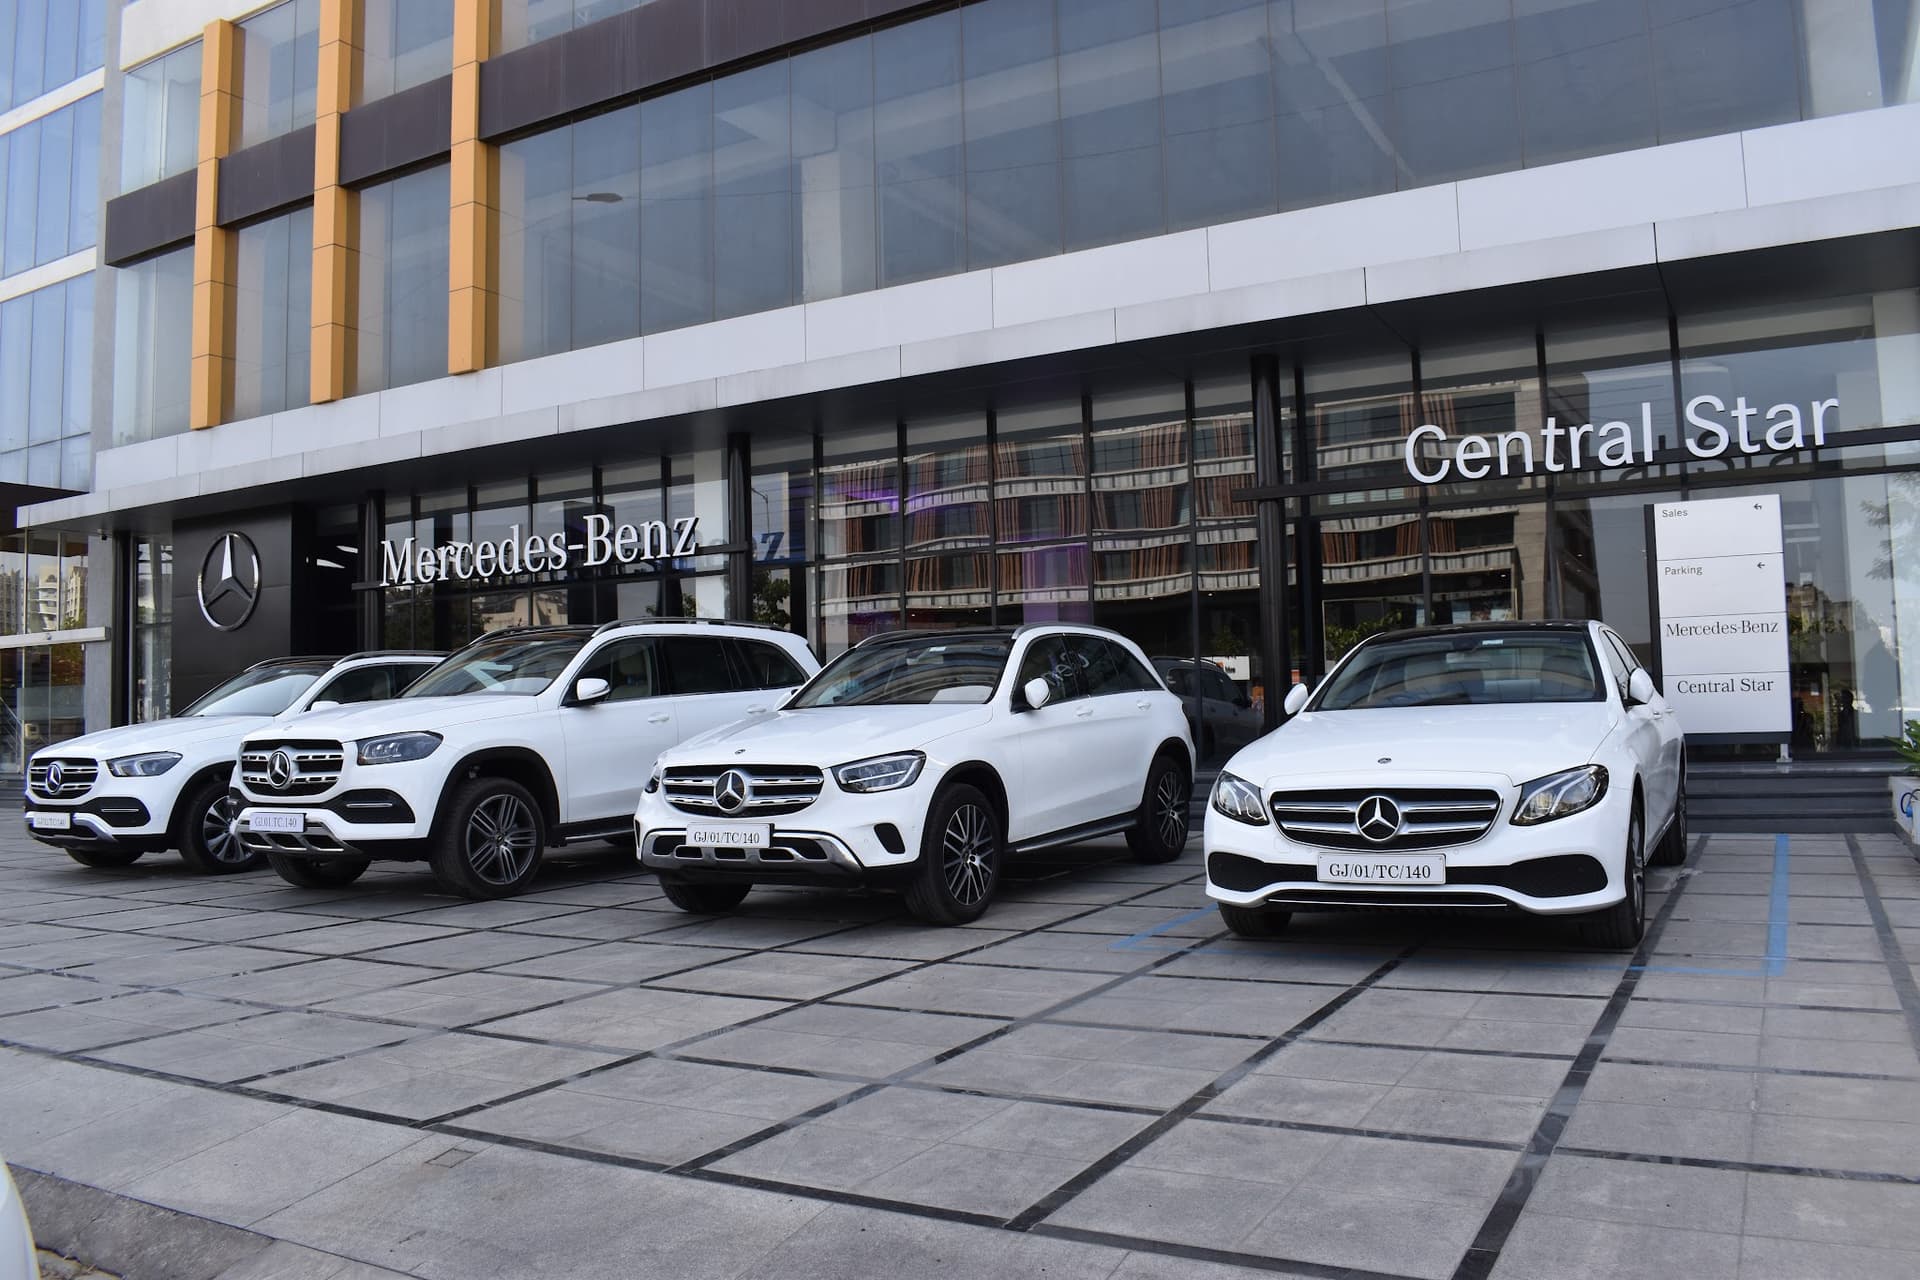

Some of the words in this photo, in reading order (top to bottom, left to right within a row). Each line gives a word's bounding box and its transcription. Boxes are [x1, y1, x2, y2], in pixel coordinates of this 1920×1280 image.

[1405, 401, 1654, 484] Central
[1685, 394, 1840, 459] Star
[1661, 508, 1688, 518] Sales
[379, 513, 700, 587] Mercedes-Benz
[1664, 566, 1703, 576] Parking
[1666, 619, 1779, 637] Mercedes-Benz
[1677, 678, 1735, 694] Central
[1740, 678, 1774, 692] Star
[694, 831, 760, 844] GJ/01/TC/140
[1329, 863, 1431, 879] GJ/01/TC/140
